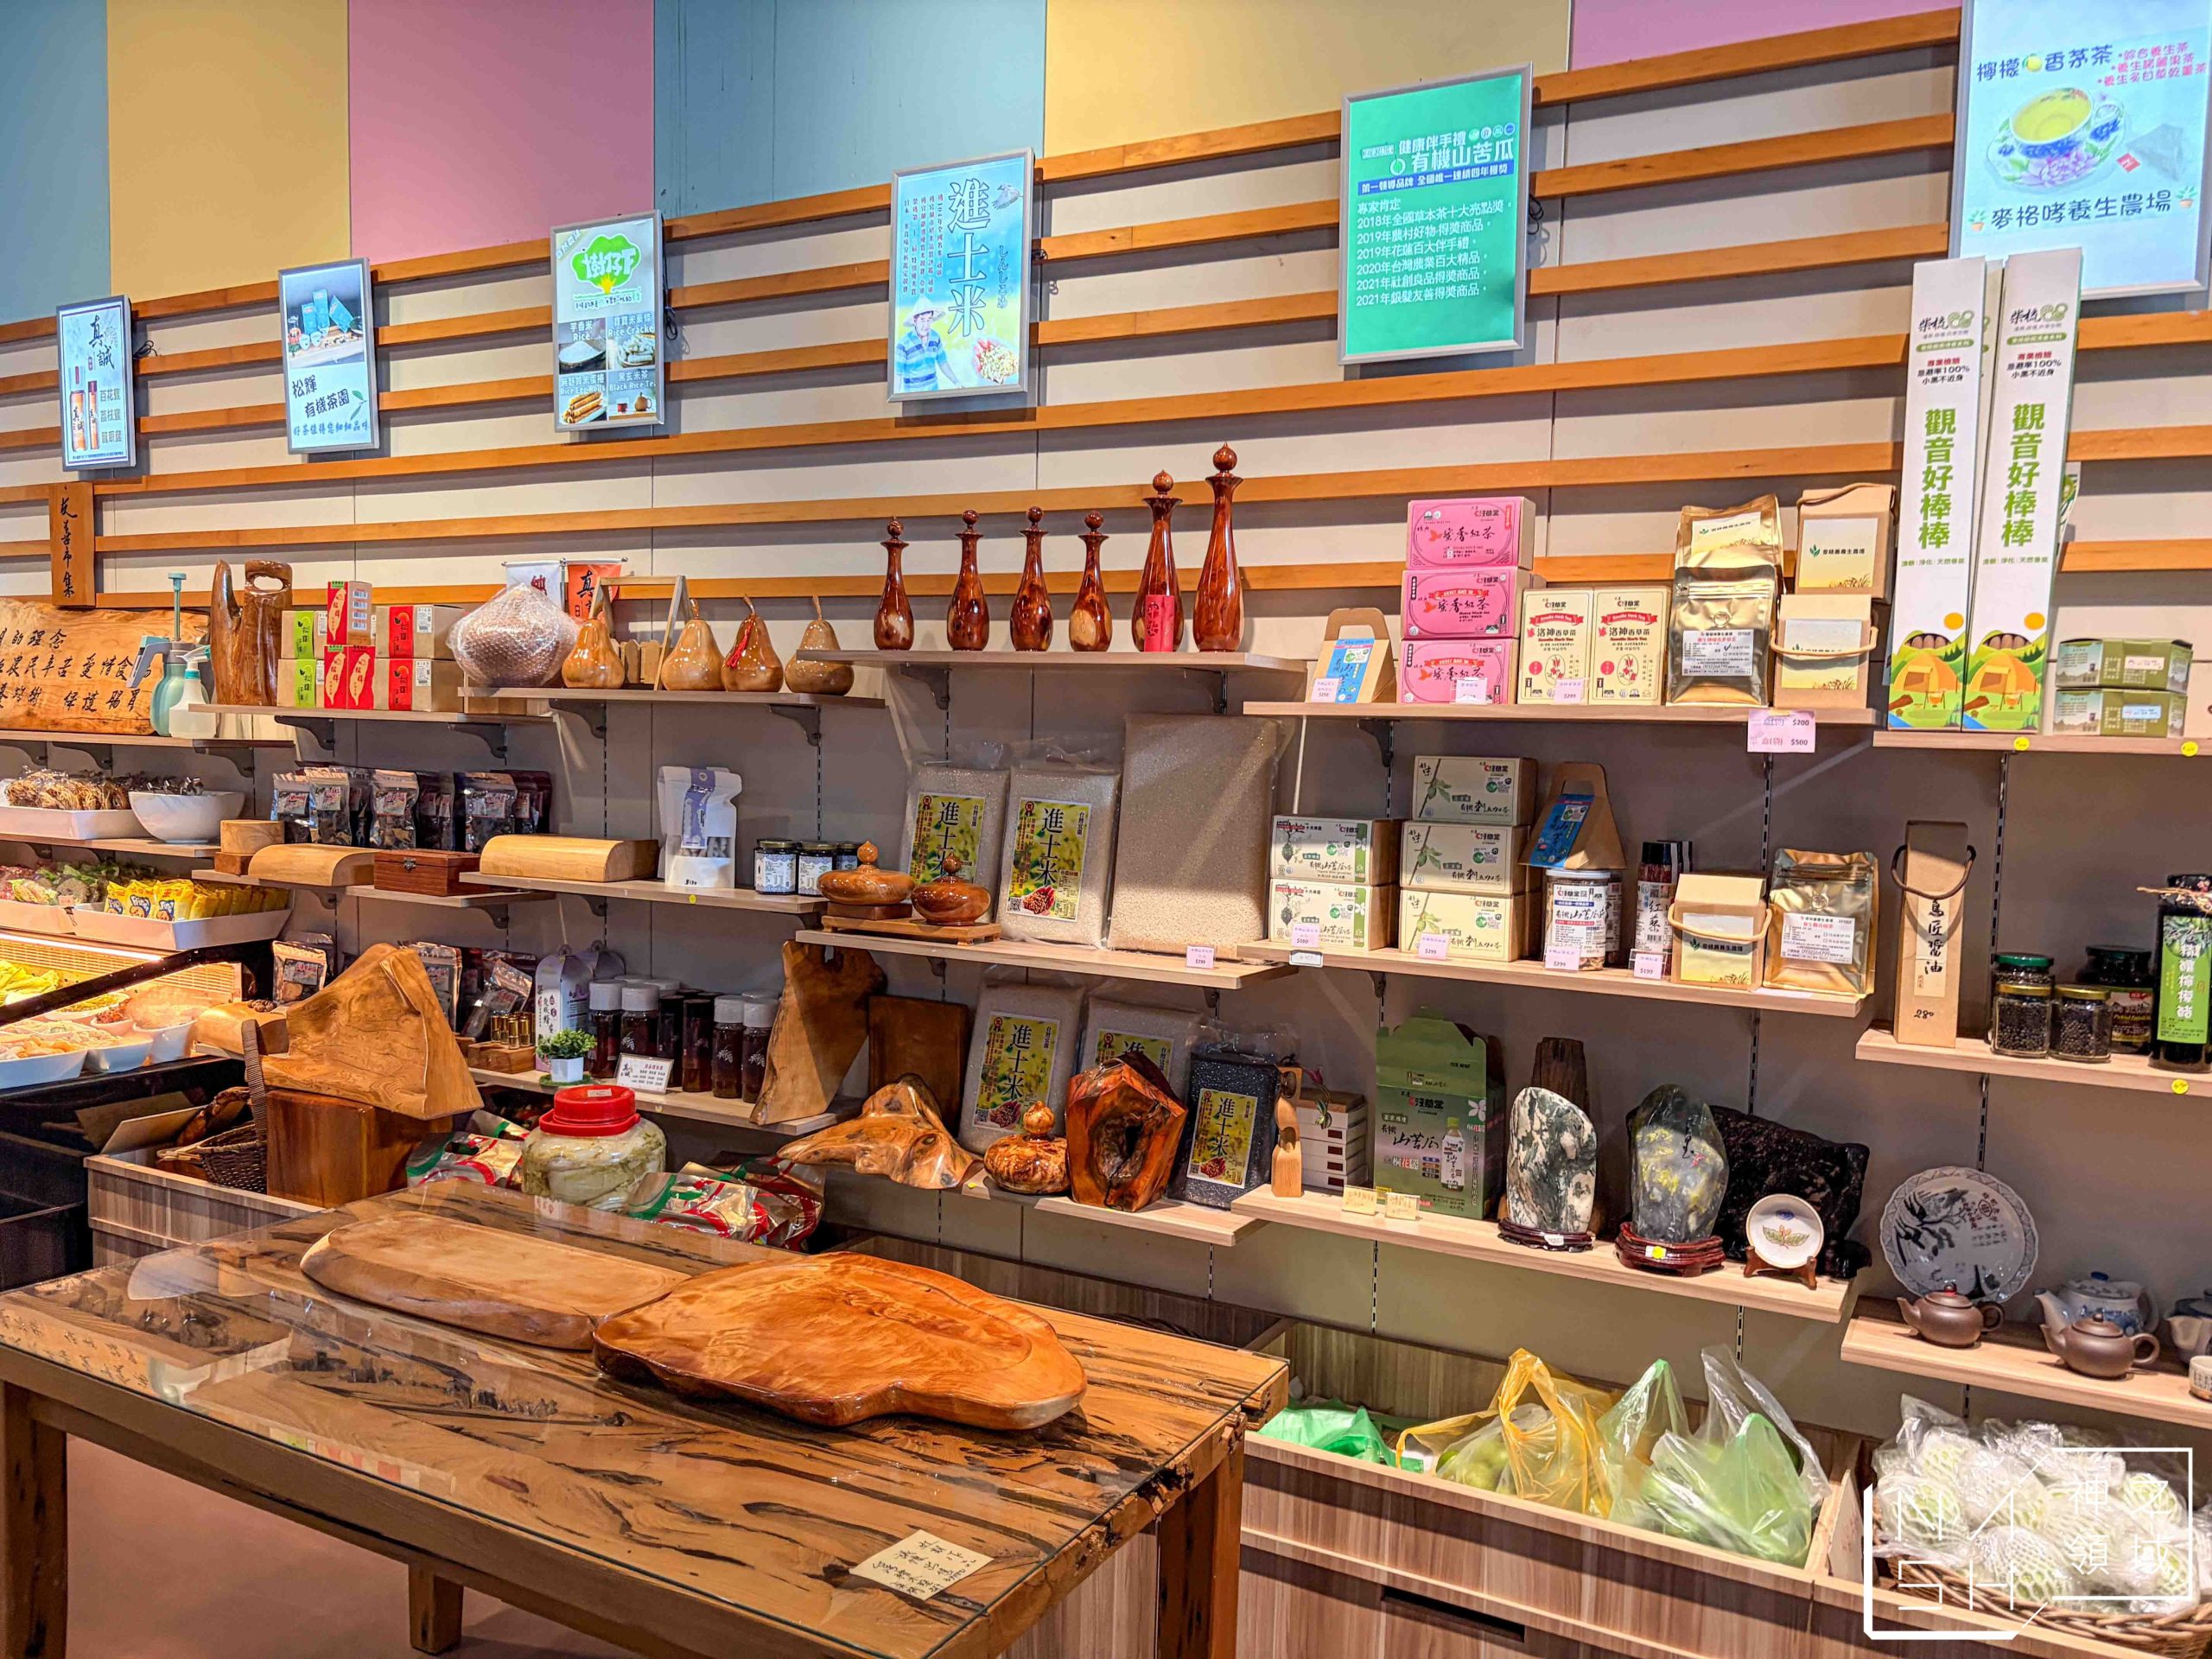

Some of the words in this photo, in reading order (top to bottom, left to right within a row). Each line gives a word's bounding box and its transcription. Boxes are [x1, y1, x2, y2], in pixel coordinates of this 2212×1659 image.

[1977, 57, 2020, 82] 檸檬
[2044, 45, 2113, 73] 香茅茶
[1399, 130, 1466, 156] 健康伴手禮
[1411, 137, 1515, 174] 有機山苦瓜
[1357, 197, 1402, 214] 專家肯定
[947, 178, 991, 337] 進士米
[573, 331, 591, 341] Rice
[607, 327, 626, 338] Rice
[609, 380, 628, 391] Black
[629, 378, 645, 390] Rice
[304, 388, 350, 418] 有機茶園
[1917, 407, 1957, 550] 觀音好棒棒
[2000, 402, 2046, 549] 觀音好棒棒
[1443, 525, 1496, 543] 蜜香紅茶
[1438, 598, 1491, 613] 蜜香紅茶
[79, 652, 151, 681] 愛惜食
[1433, 665, 1485, 682] 蜜香紅茶
[1035, 807, 1065, 885] 進士米
[1003, 1023, 1033, 1101] 進士米
[1211, 1096, 1237, 1158] 進士米
[1392, 1131, 1440, 1150] 山苦瓜
